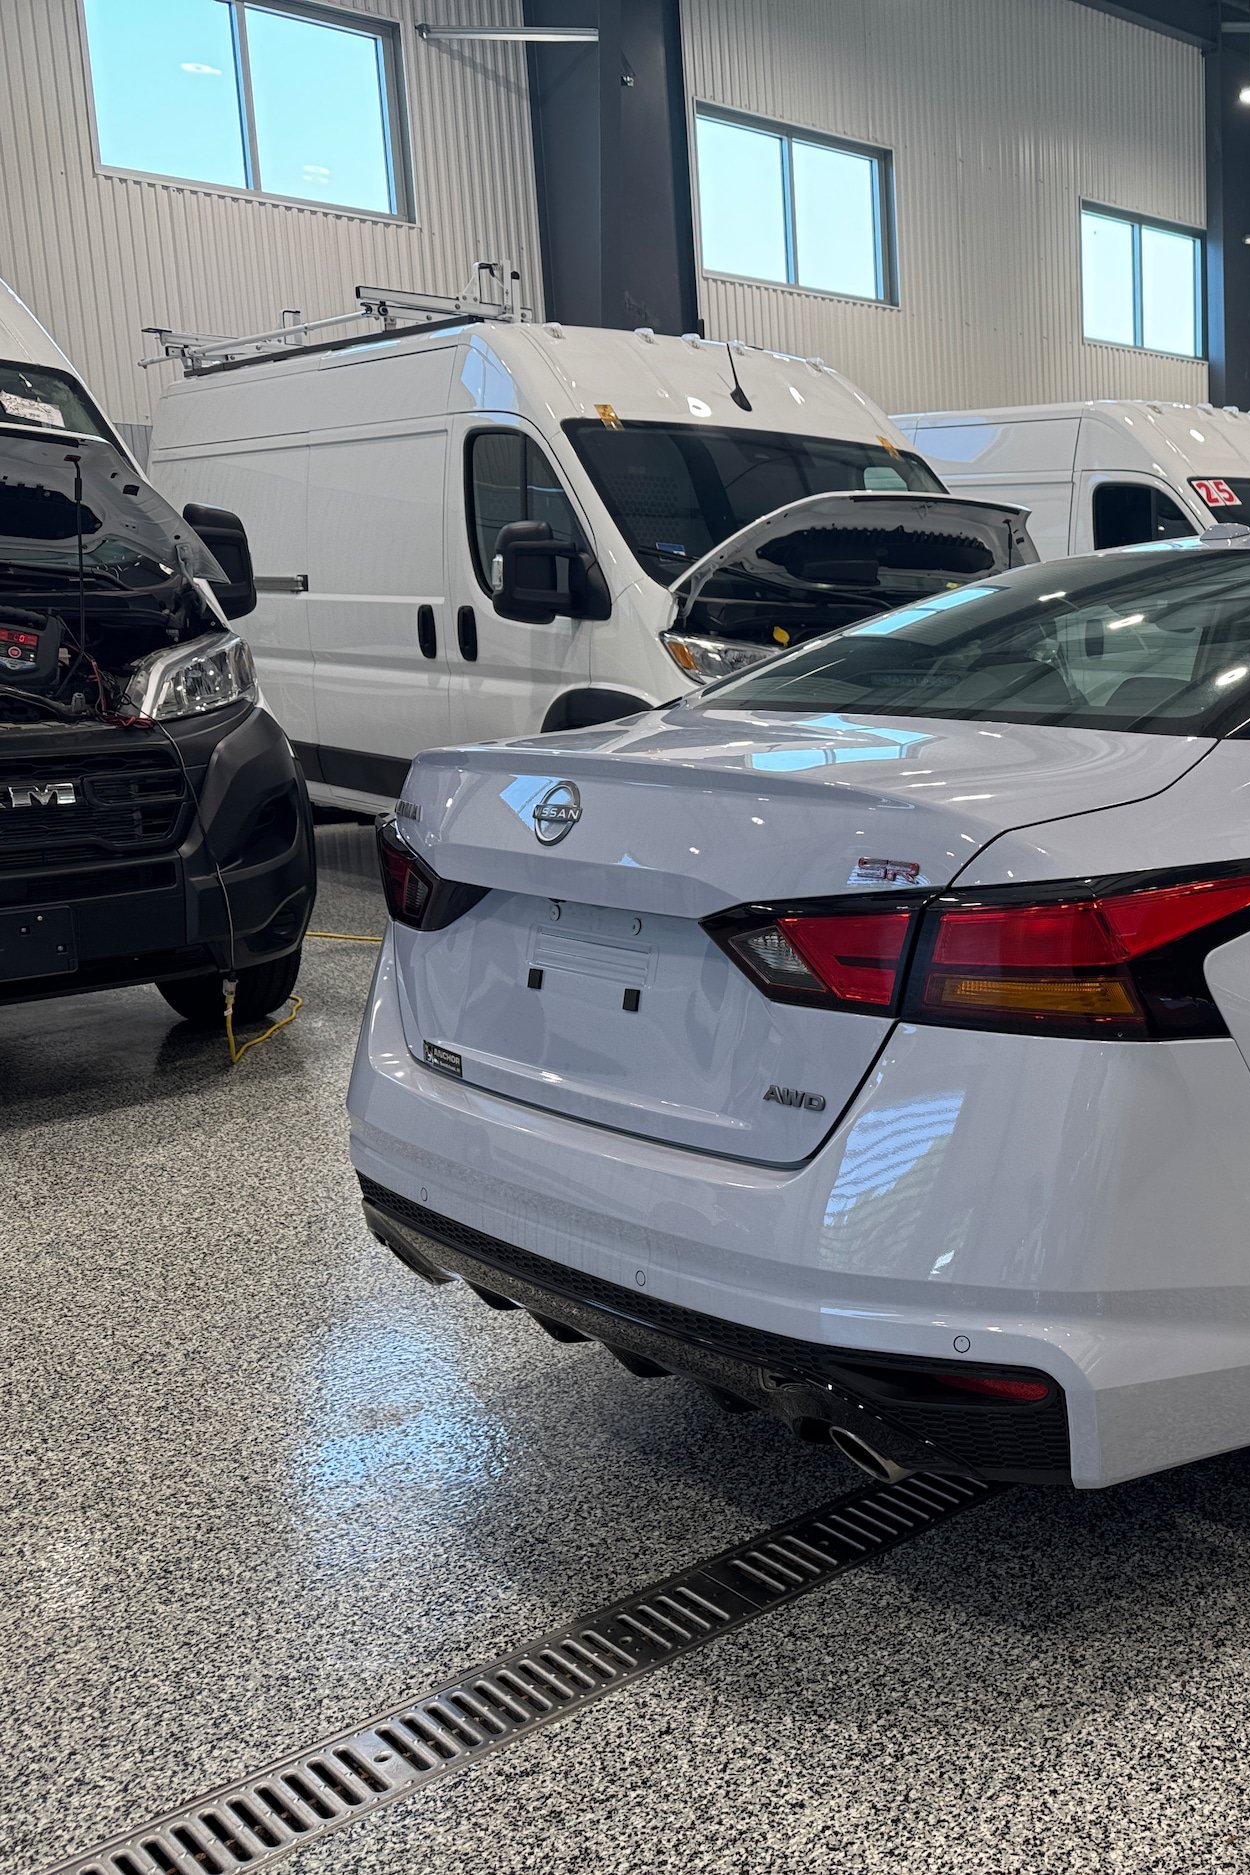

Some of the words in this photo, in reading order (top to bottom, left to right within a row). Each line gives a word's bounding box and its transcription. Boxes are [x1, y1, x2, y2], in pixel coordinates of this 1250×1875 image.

[1196, 482, 1234, 502] 25
[535, 806, 579, 820] NISSAN
[857, 857, 920, 885] SR
[434, 1048, 460, 1065] ANCHOR
[763, 1085, 826, 1112] AWD
